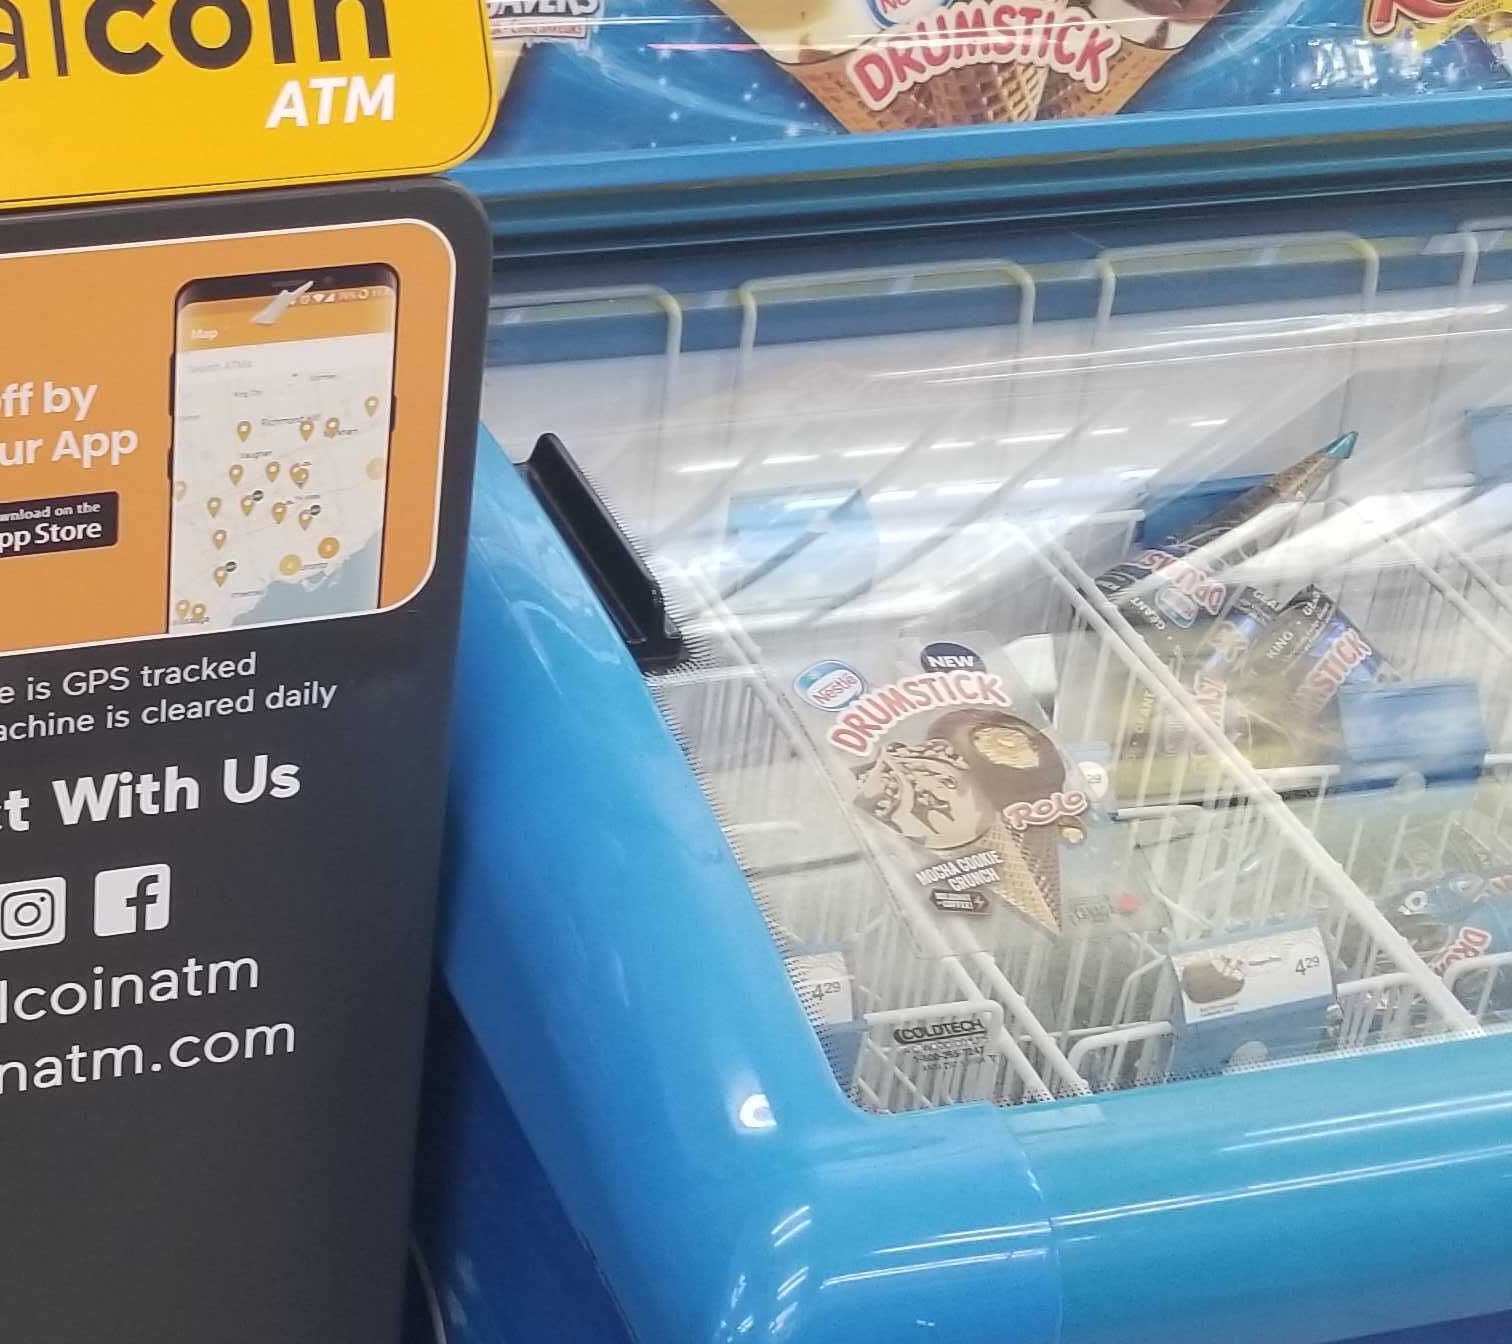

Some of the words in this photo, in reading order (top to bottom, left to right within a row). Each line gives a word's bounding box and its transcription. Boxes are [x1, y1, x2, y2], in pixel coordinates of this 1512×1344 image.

[853, 4, 1114, 103] DRUMSTICK
[265, 74, 397, 129] ATM
[43, 380, 98, 423] by
[51, 426, 139, 470] App
[54, 504, 74, 518] on
[76, 500, 102, 516] the
[34, 519, 103, 546] Store
[26, 676, 52, 702] is
[62, 667, 131, 698] GPS
[139, 651, 258, 690] tracked
[927, 655, 975, 669] NEW
[105, 704, 131, 730] is
[140, 688, 255, 726] cleared
[265, 679, 338, 714] daily
[831, 674, 1009, 754] DRUMSTICK
[51, 766, 201, 827] With
[222, 754, 302, 805] Us
[915, 861, 962, 886] MOCHA
[948, 867, 1000, 892] CRUNCH
[901, 1018, 985, 1040] COLDTECH
